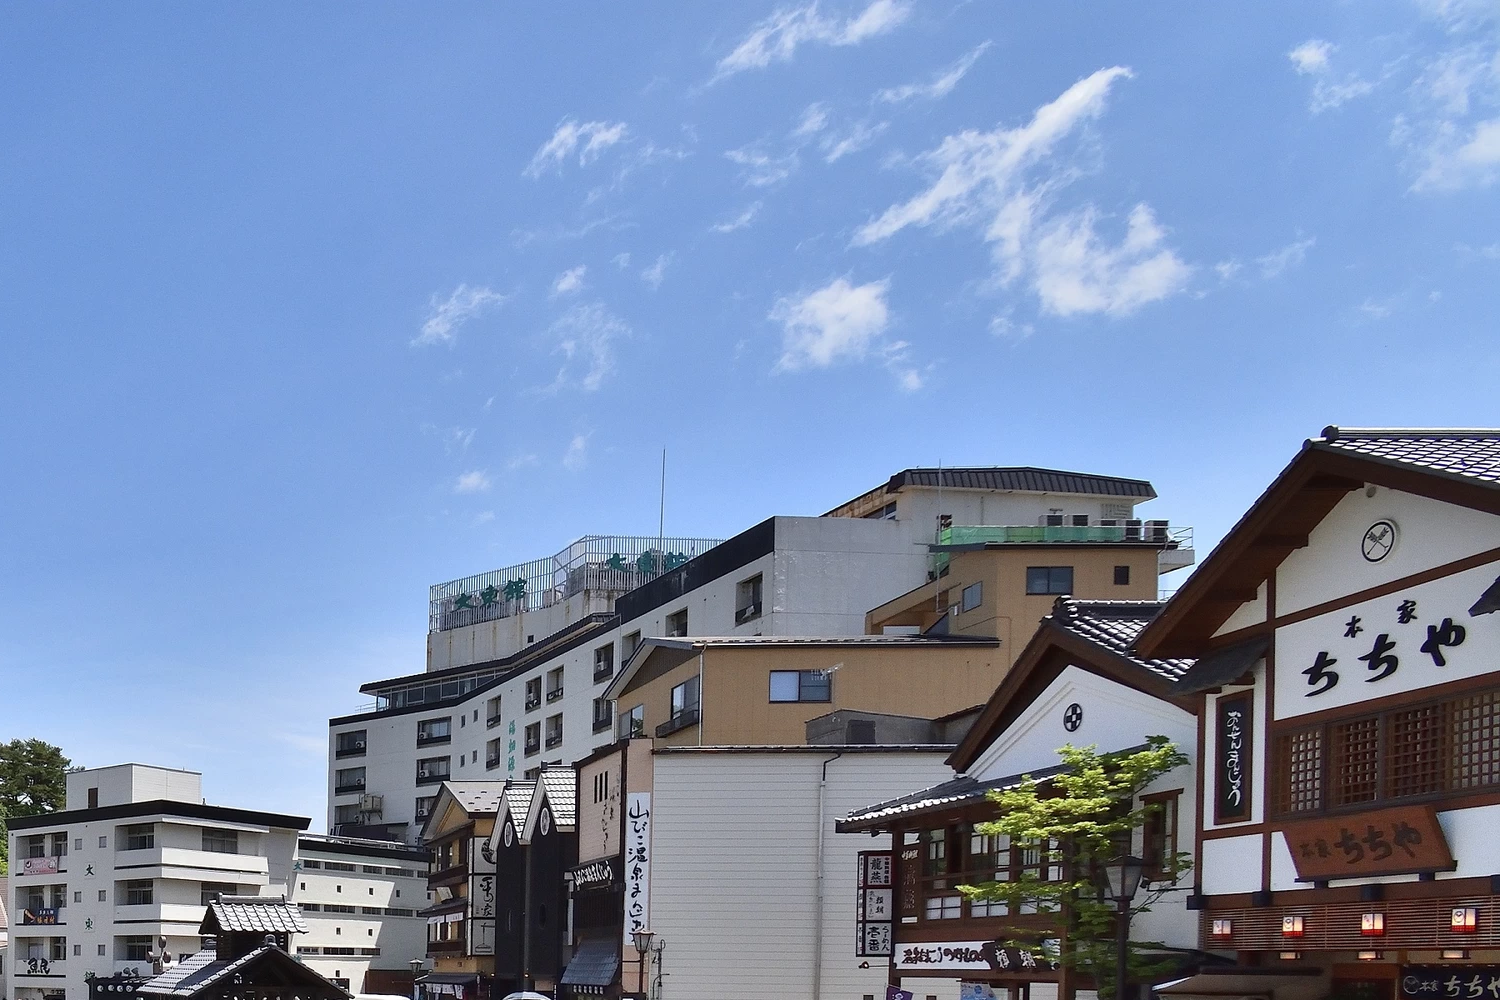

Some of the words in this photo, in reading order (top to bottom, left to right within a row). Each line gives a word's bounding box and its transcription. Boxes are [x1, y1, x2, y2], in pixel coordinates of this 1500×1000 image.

[1343, 600, 1418, 639] 本家
[1301, 617, 1467, 698] ちちや
[1334, 821, 1423, 865] ちちや
[628, 799, 650, 942] 山びこ温泉まんじゅ
[867, 926, 880, 951] 壱番
[882, 925, 890, 952] らーめん
[1419, 979, 1439, 993] 本家
